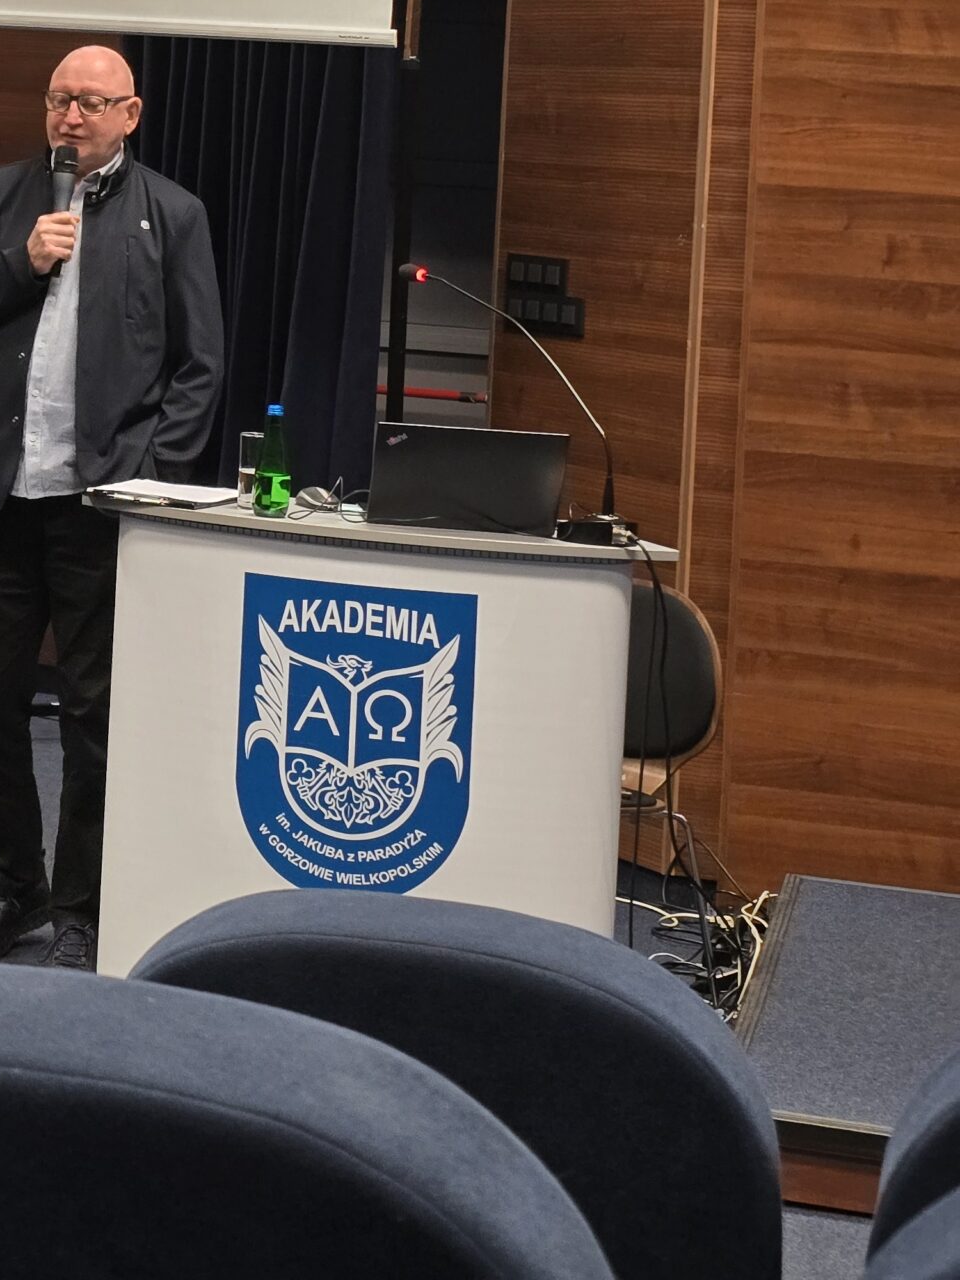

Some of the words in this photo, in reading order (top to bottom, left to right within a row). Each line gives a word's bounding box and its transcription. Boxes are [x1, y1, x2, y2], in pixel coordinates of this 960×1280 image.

[278, 599, 440, 648] AKADEMIA
[364, 689, 413, 743] Ω
[258, 823, 271, 836] w
[268, 834, 334, 882] GORZOWIE
[335, 841, 444, 886] WIELKOPOLSKIM
[275, 812, 291, 833] im.
[292, 830, 345, 861] JAKUBA
[346, 852, 355, 862] z
[357, 829, 427, 862] PARADYŻA
